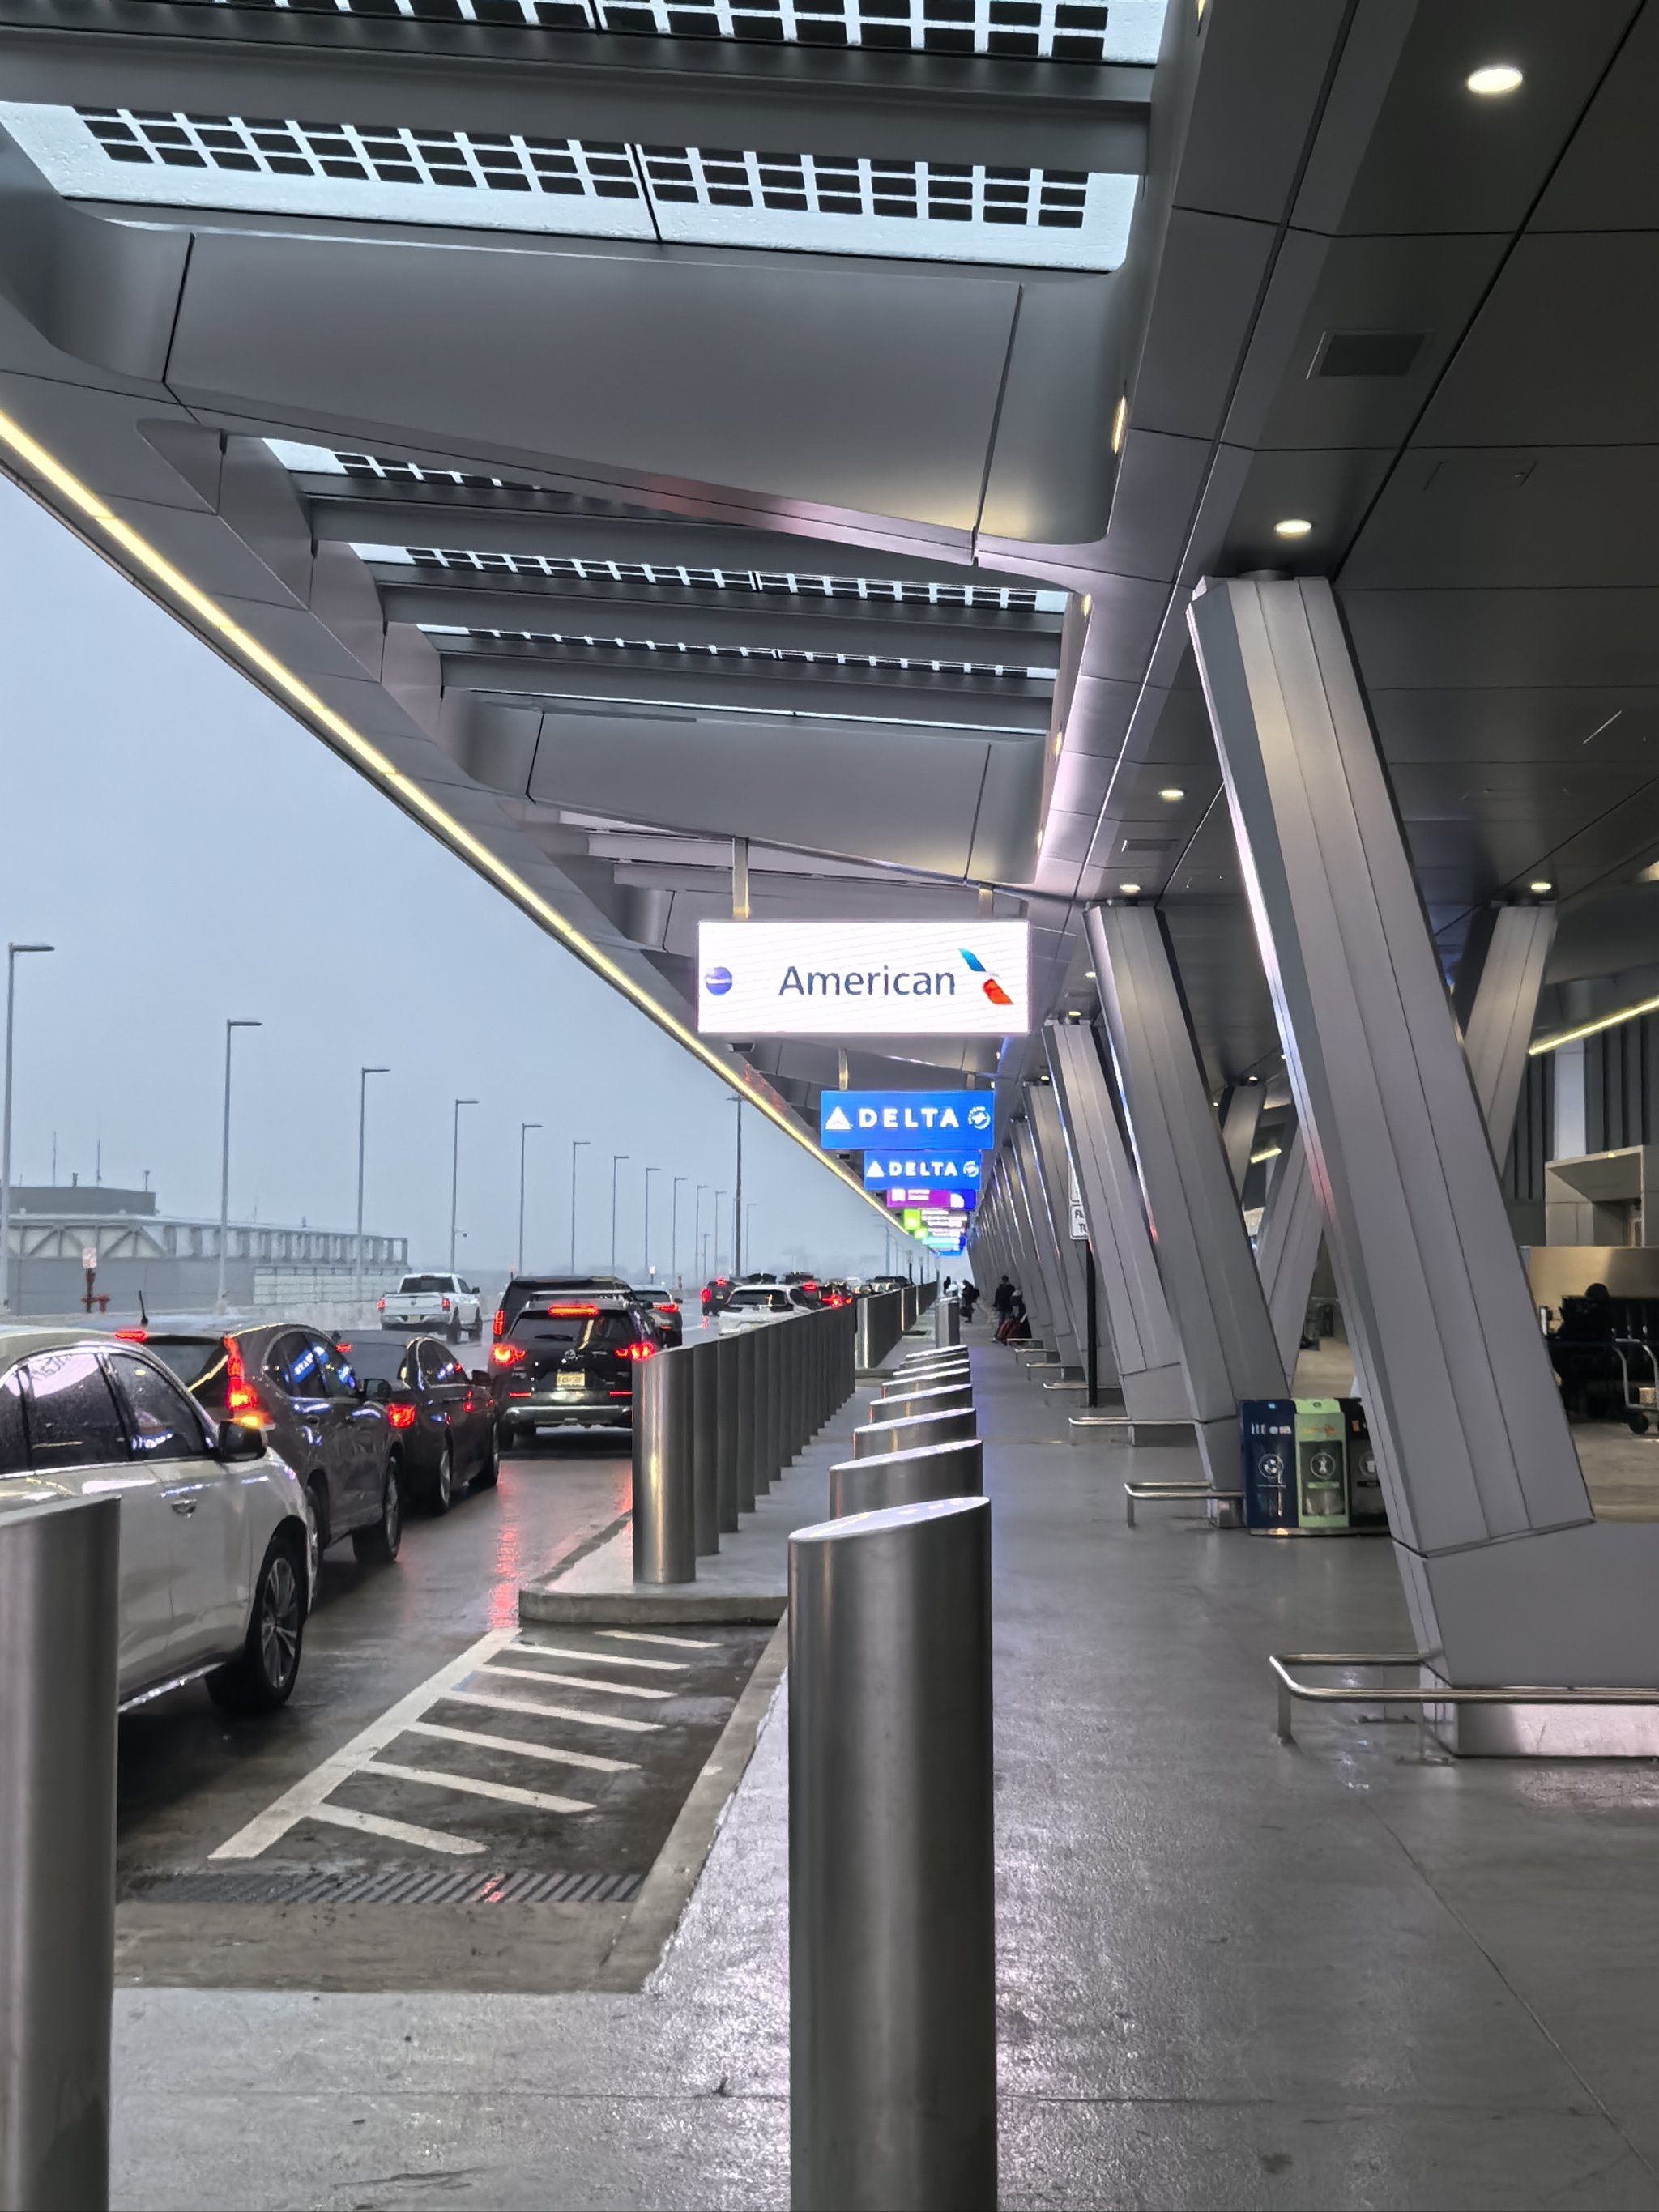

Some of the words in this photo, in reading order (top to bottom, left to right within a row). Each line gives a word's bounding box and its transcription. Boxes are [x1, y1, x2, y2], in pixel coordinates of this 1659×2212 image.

[778, 965, 955, 995] American
[859, 1107, 960, 1128] DELTA
[889, 1161, 958, 1177] DELTA
